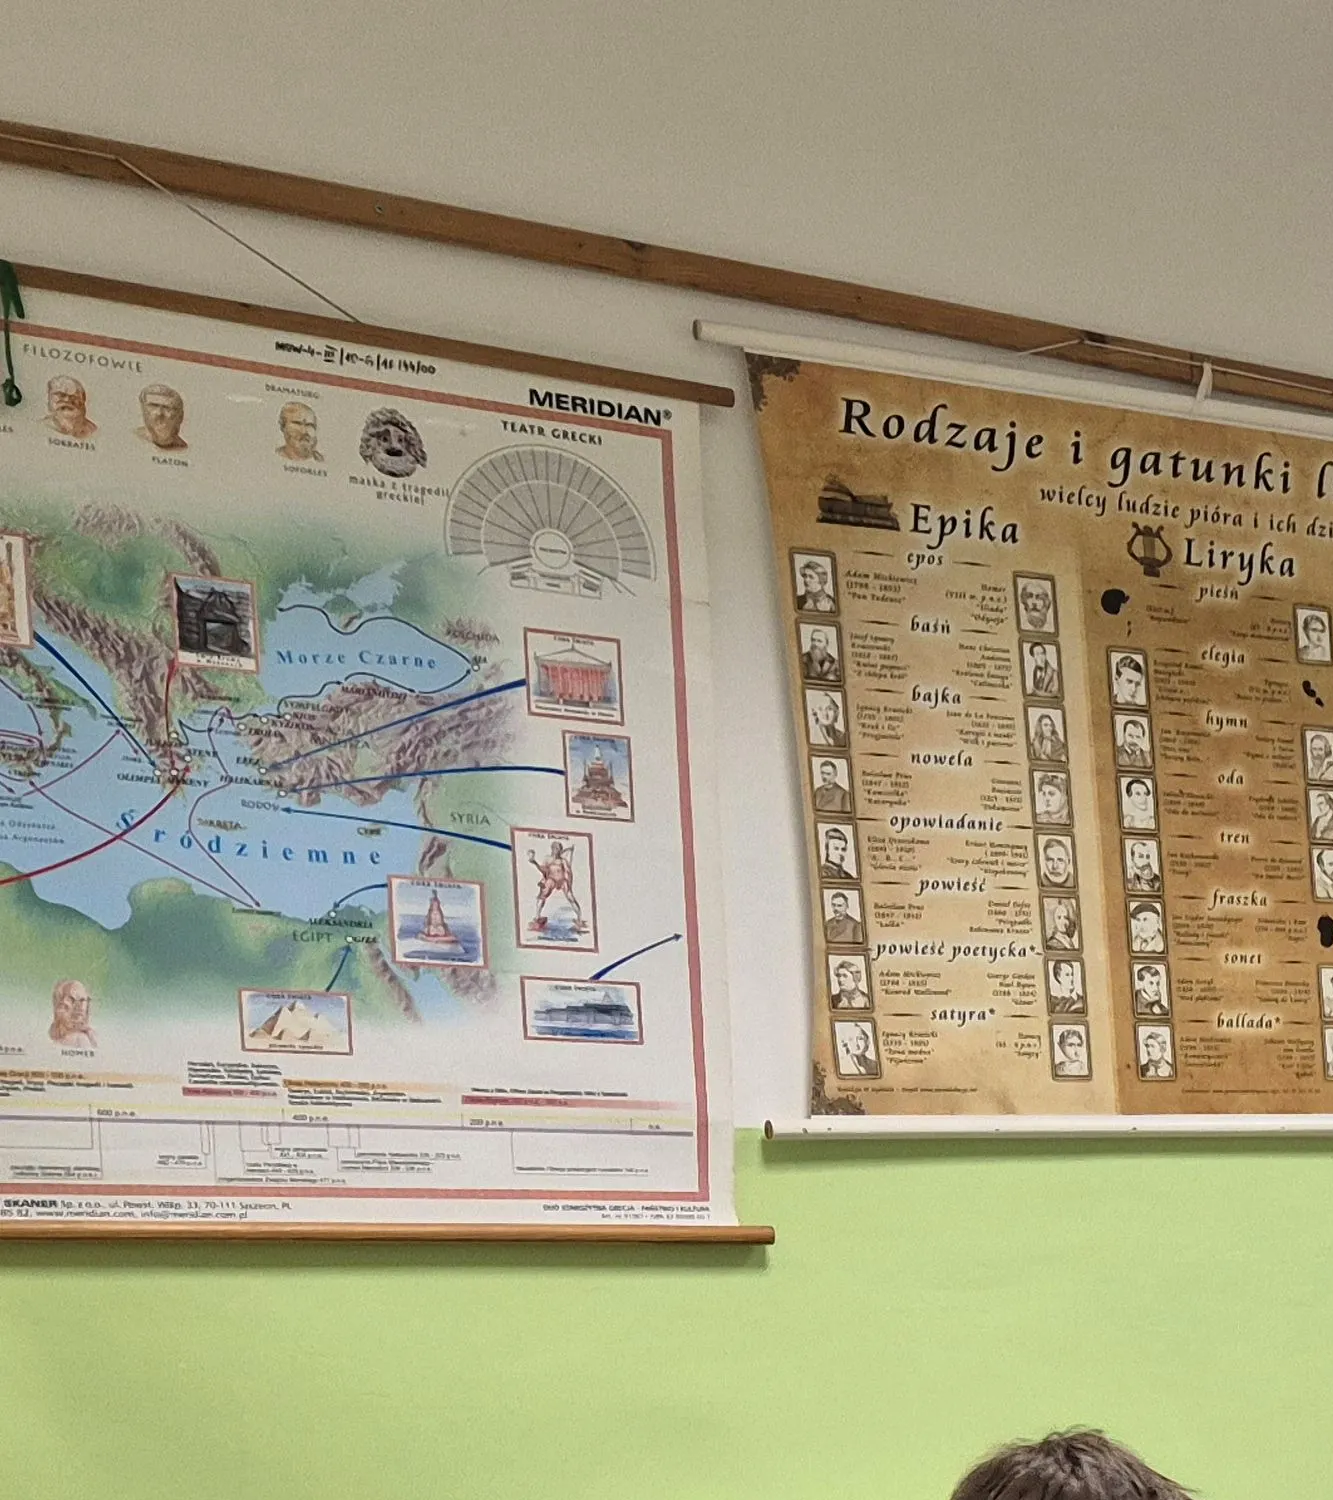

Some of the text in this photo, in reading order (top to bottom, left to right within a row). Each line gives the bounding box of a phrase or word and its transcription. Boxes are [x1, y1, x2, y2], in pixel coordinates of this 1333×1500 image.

[501, 420, 603, 446] TEATR GRECKI
[839, 397, 1044, 472] Rodzaje
[1071, 430, 1083, 465] i
[1107, 450, 1291, 488] gatunki
[1039, 485, 1106, 517] wielcy
[1117, 491, 1180, 519] ludzie
[1185, 504, 1242, 528] pióra
[1253, 509, 1259, 529] i
[1269, 513, 1297, 534] ich
[910, 503, 1020, 550] Epika
[907, 552, 943, 570] epos
[1184, 537, 1295, 586] Liryka
[1195, 586, 1239, 602] pieśń
[910, 615, 950, 634] baśń
[277, 650, 438, 669] Morze Czarne
[1201, 645, 1245, 668] elegia
[912, 684, 962, 709] bajka
[1206, 710, 1248, 732] hymn
[911, 750, 973, 767] nowela
[1218, 769, 1244, 785] oda
[450, 813, 491, 826] SYRIA
[890, 813, 1003, 833] opowiadanie
[1220, 831, 1250, 844] tren
[915, 878, 987, 896] powieść
[1208, 888, 1268, 911] fraszka
[292, 931, 333, 944] EGIPT
[871, 940, 945, 961] powieść
[1223, 952, 1262, 965] sonet
